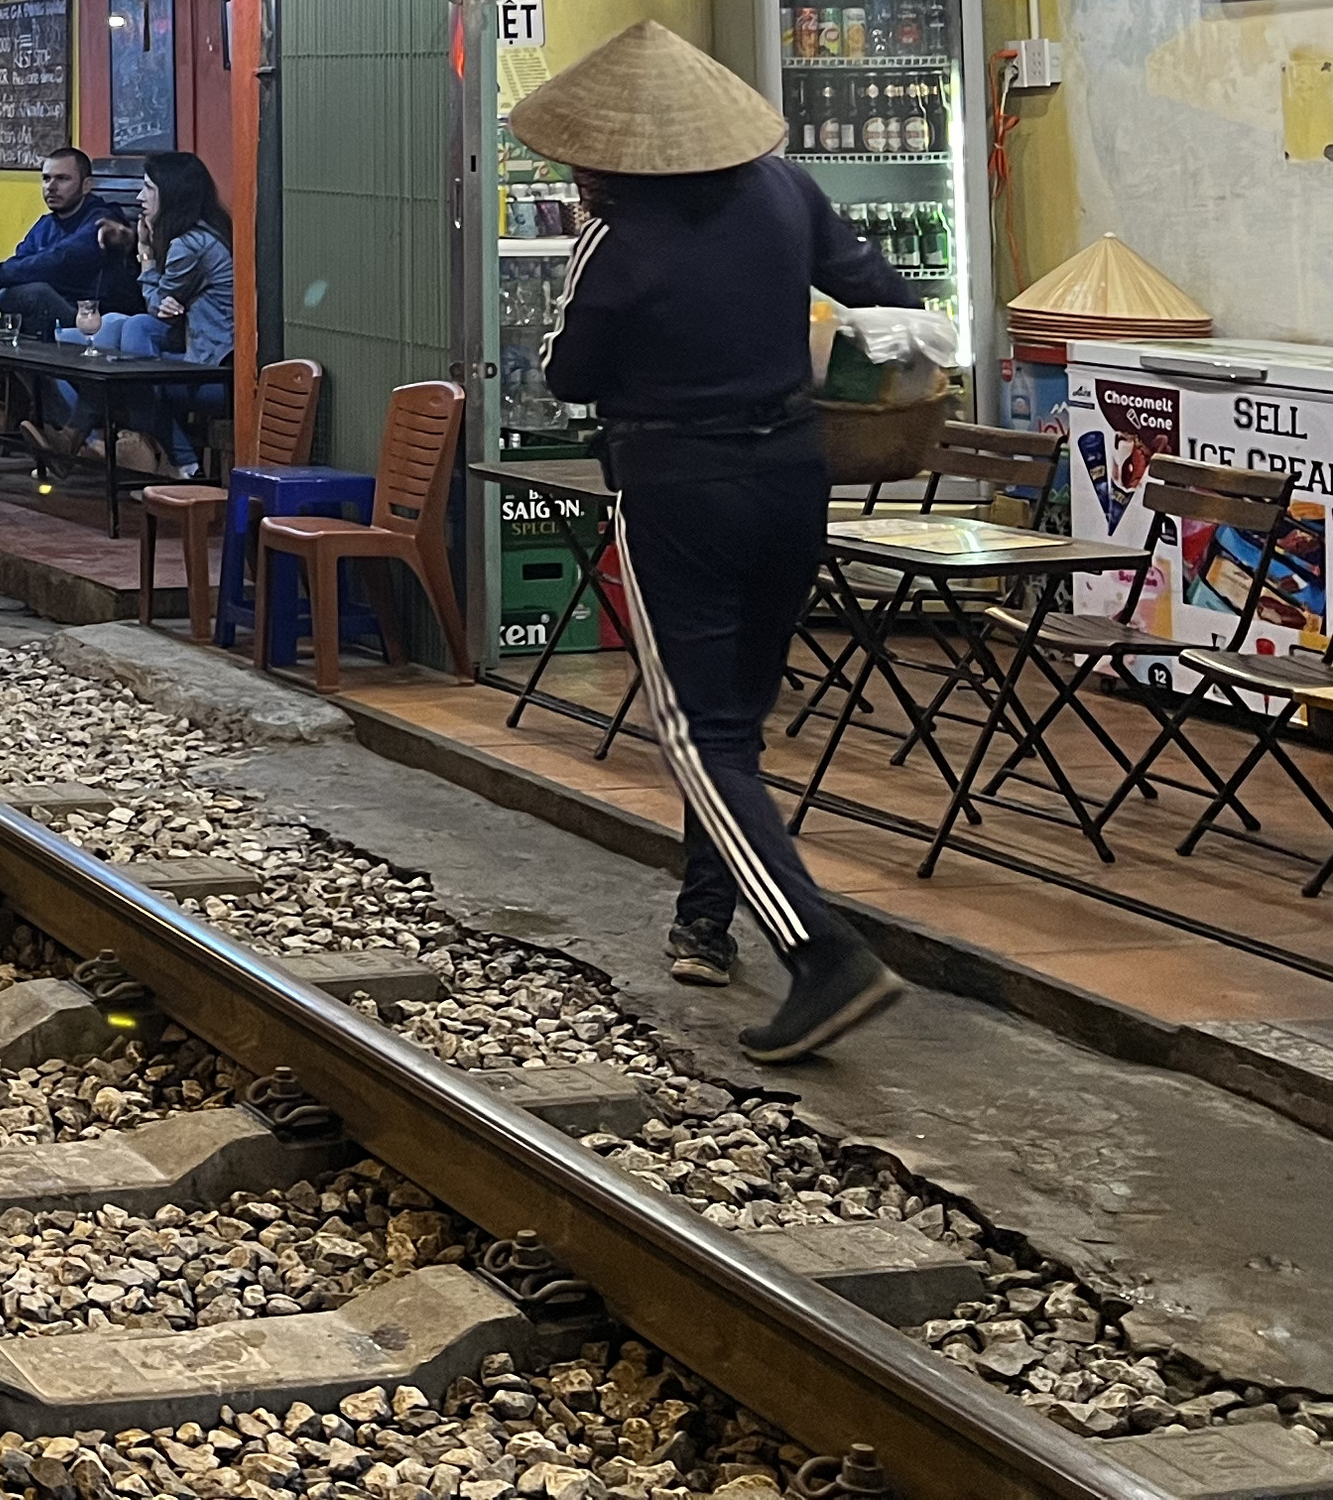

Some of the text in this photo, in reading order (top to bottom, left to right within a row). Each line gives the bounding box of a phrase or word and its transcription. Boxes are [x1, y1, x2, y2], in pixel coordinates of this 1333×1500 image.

[1104, 389, 1173, 413] Chocomelt
[1139, 412, 1173, 431] Cone
[1233, 397, 1308, 440] SELL
[1187, 437, 1333, 496] ICE CREA
[1154, 669, 1167, 684] 12
